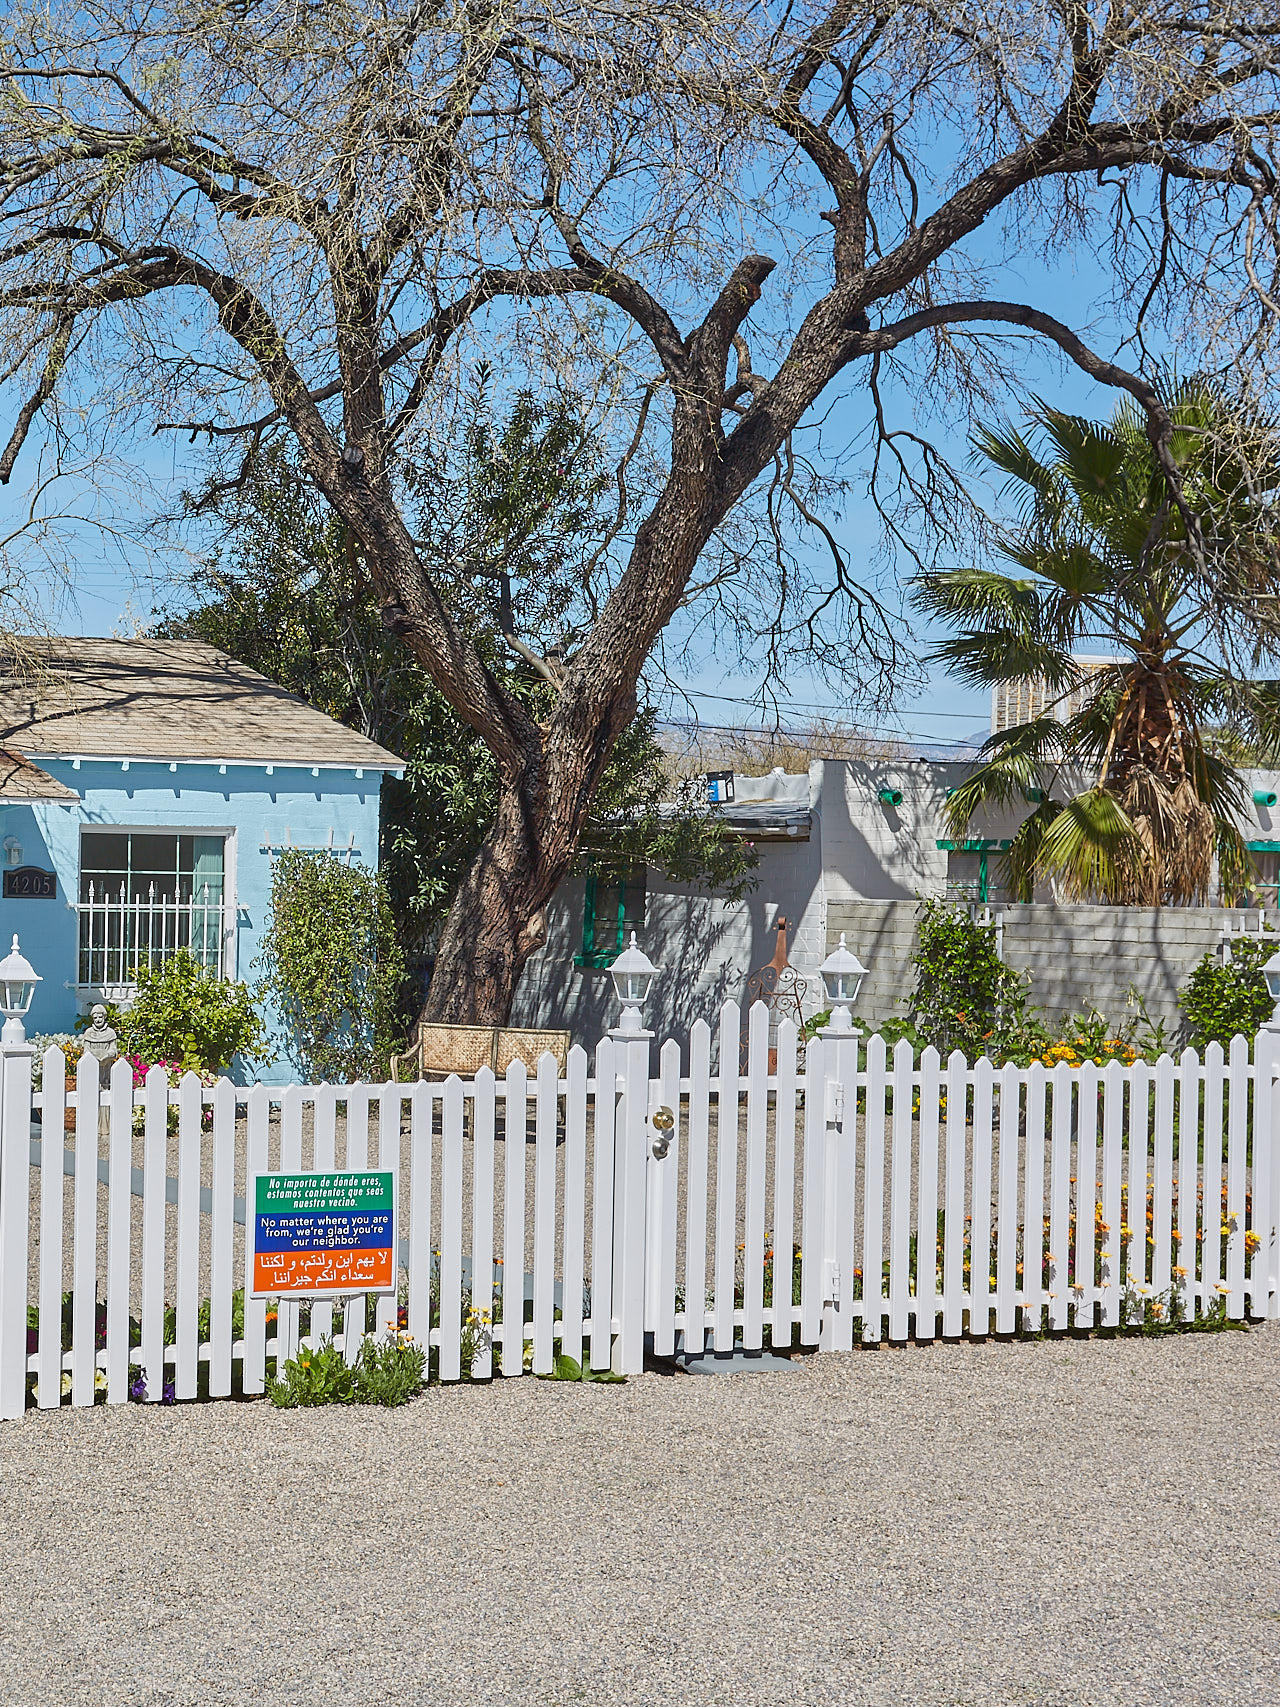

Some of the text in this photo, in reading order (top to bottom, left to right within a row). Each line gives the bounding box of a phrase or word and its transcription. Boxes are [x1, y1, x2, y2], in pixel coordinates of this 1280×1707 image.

[11, 876, 50, 894] 4205
[269, 1175, 381, 1190] No importa de dónde eres,
[266, 1187, 384, 1199] estamos contentos que seas
[293, 1197, 358, 1208] nuestro vecino.
[261, 1216, 388, 1227] No matter where you are
[265, 1224, 384, 1237] from, we're glad you're
[292, 1236, 361, 1247] our neighbor.
[356, 1255, 375, 1269] يهم
[378, 1251, 388, 1264] لا
[340, 1269, 374, 1282] سعداء
